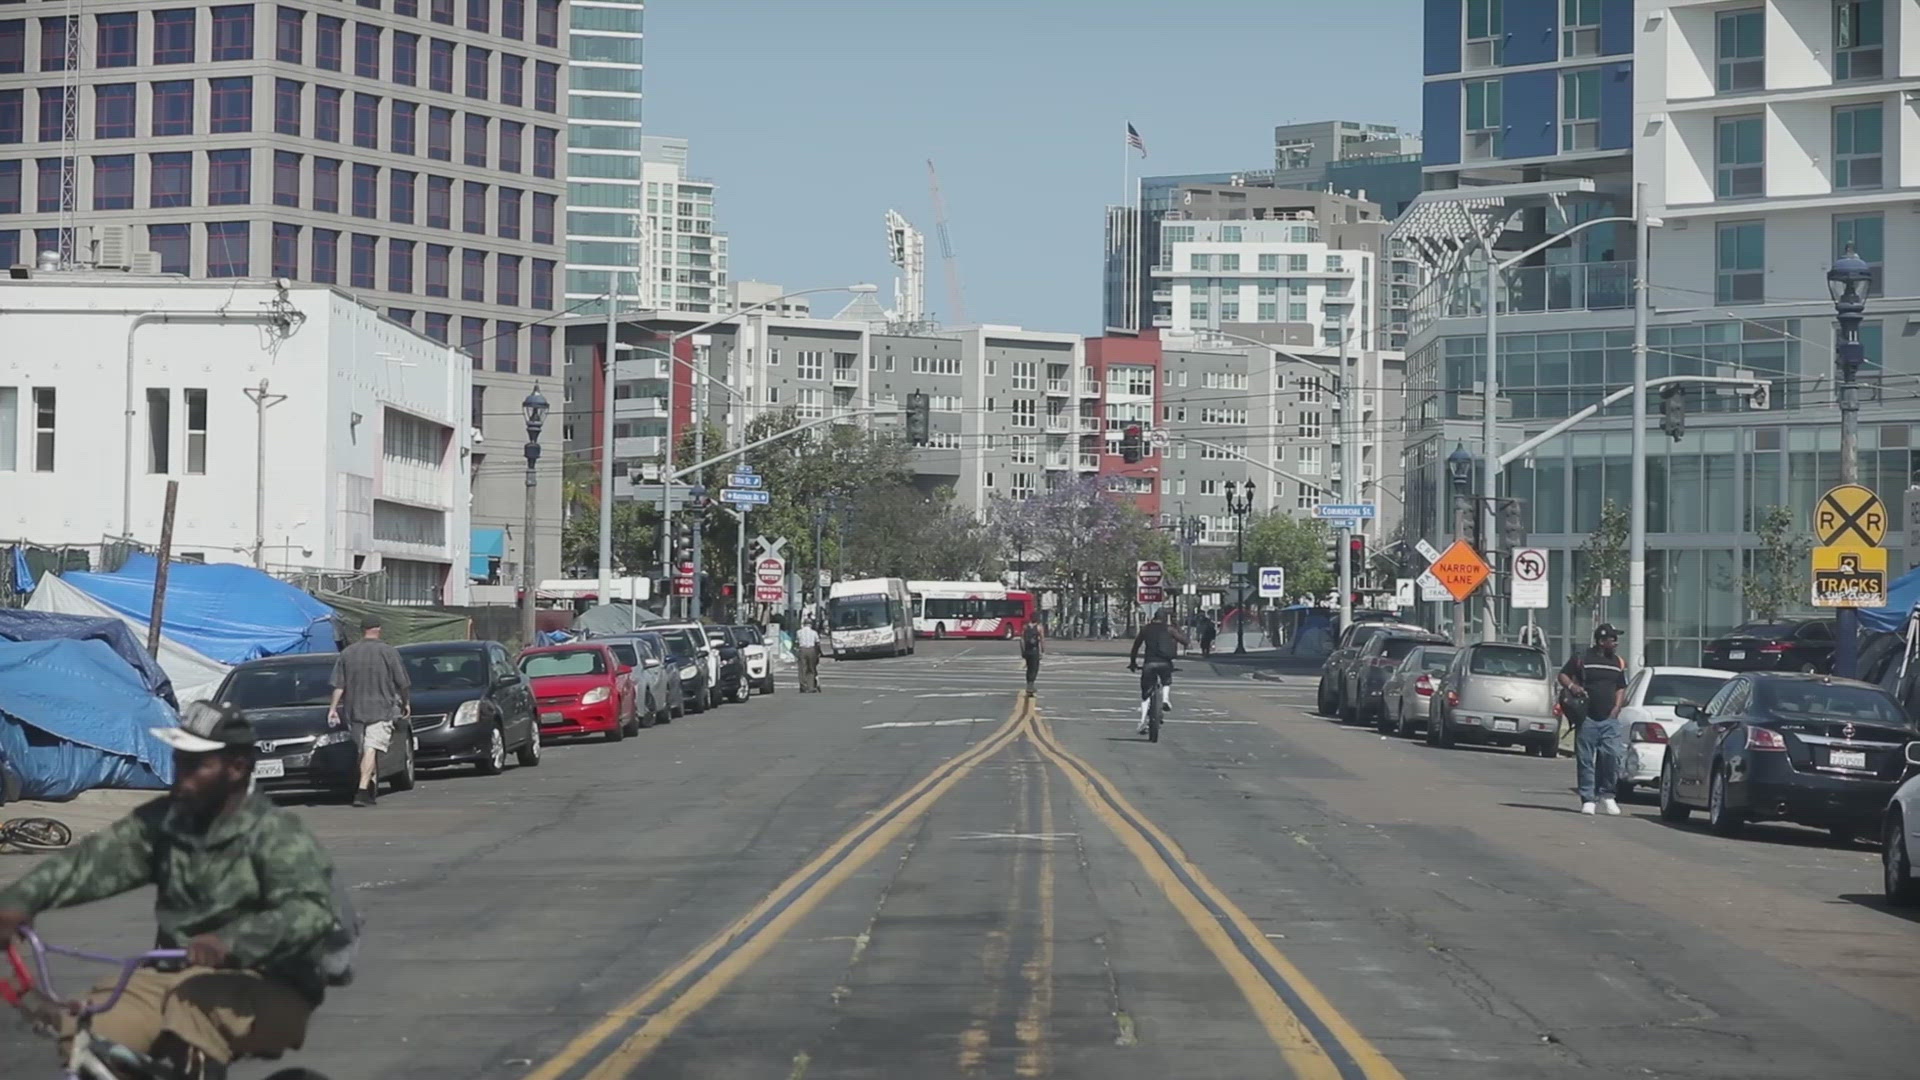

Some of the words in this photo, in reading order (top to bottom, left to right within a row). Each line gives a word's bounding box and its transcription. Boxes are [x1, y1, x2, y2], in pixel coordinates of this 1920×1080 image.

[1322, 506, 1361, 516] COMMERCIAL
[1419, 542, 1438, 561] CRO
[1440, 564, 1480, 573] NARROW
[1262, 574, 1281, 586] ACE
[1419, 574, 1432, 586] RA
[1447, 576, 1472, 584] LANE
[1820, 578, 1879, 593] TRACKS
